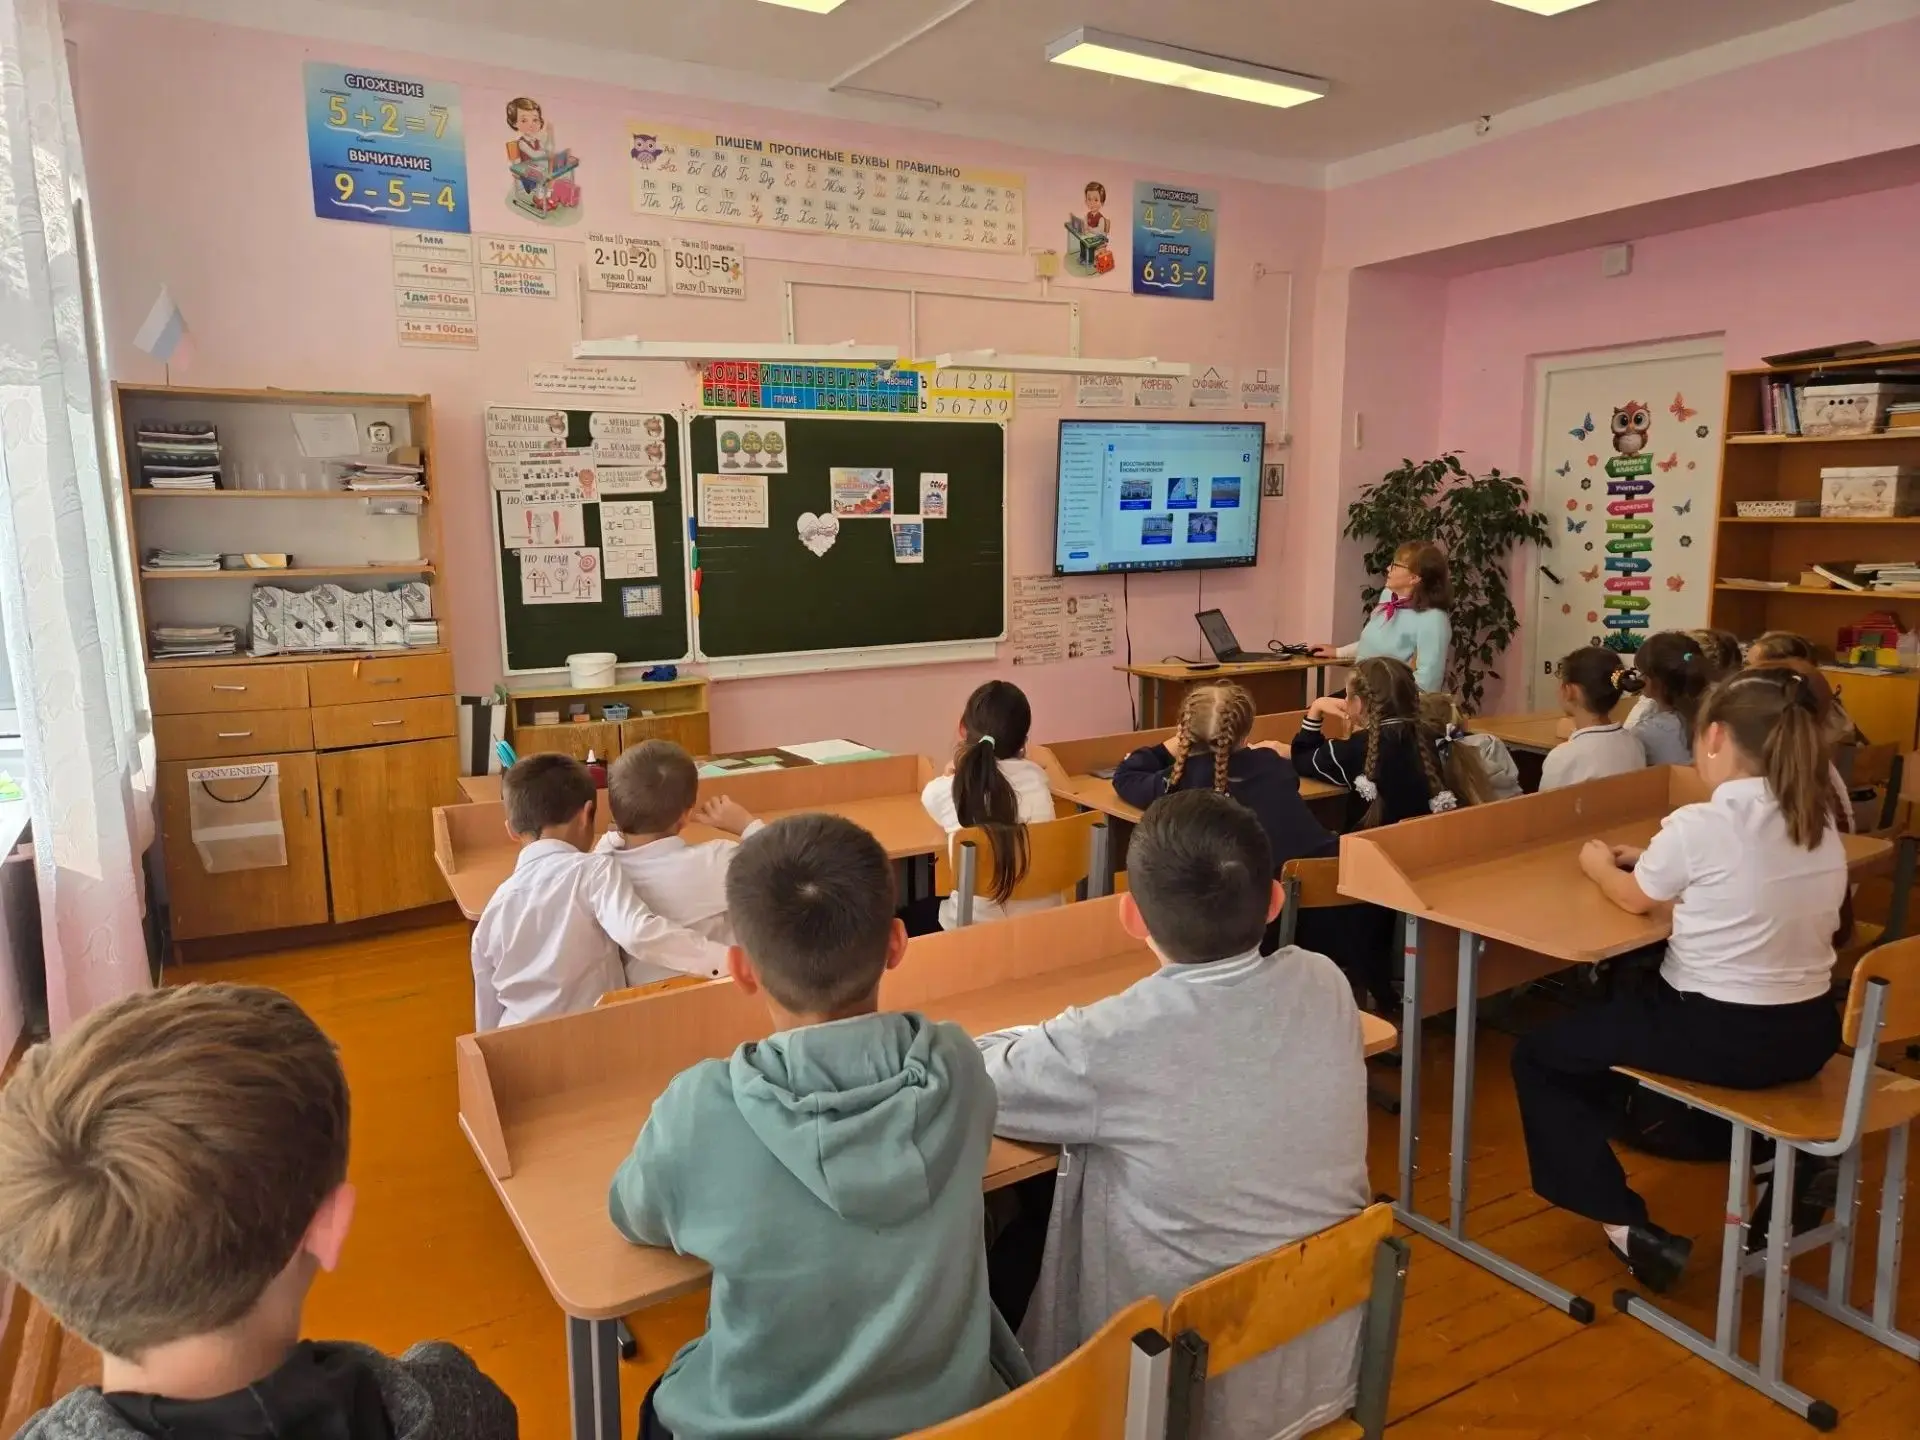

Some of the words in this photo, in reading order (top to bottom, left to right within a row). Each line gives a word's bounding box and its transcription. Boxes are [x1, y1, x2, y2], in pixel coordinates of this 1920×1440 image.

[345, 74, 424, 97] СЛОЖЕНИЕ
[329, 95, 347, 125] 5
[380, 103, 399, 132] 2
[429, 110, 448, 138] 7
[348, 148, 432, 171] ВЫЧИТАНИЕ
[715, 136, 762, 151] ПИШЕМ
[769, 143, 844, 163] ПРОПИСНЫЕ
[851, 154, 889, 169] БУКВЫ
[896, 159, 960, 178] ПРАВИЛЬНО
[334, 173, 354, 200] 9
[388, 179, 405, 207] 5
[437, 186, 456, 212] 4
[1153, 188, 1198, 204] УМНОЖЕНИЕ
[1144, 206, 1154, 226] 4
[1171, 209, 1181, 230] 2
[416, 234, 444, 245] 1мм
[489, 241, 505, 251] 1м
[519, 244, 548, 255] 10дм
[1159, 243, 1191, 256] ДЕЛЕНИЕ
[422, 264, 448, 274] 1см
[1144, 260, 1155, 281] 6
[1170, 263, 1181, 283] 3
[1197, 266, 1207, 285] 2
[676, 282, 697, 291] СРАЗУ
[718, 286, 742, 296] УБЕРИ!
[404, 292, 469, 305] 1дм=10см
[404, 322, 421, 331] 1м
[436, 324, 474, 334] 100см
[968, 372, 977, 390] 2
[984, 374, 992, 390] 3
[998, 374, 1008, 391] 4
[1080, 376, 1124, 386] ПРИСТАВКА
[1141, 378, 1172, 391] КОРЕНЬ
[1192, 379, 1228, 390] СУФФИКС
[1242, 384, 1280, 394] ОКОНЧАНИЕ
[774, 394, 798, 404] ГЛУХИЕ
[936, 397, 945, 414] 5
[952, 398, 960, 415] 6
[968, 398, 976, 416] 7
[983, 399, 992, 416] 8
[999, 400, 1008, 416] 9
[192, 764, 274, 780] CONVENIENT
